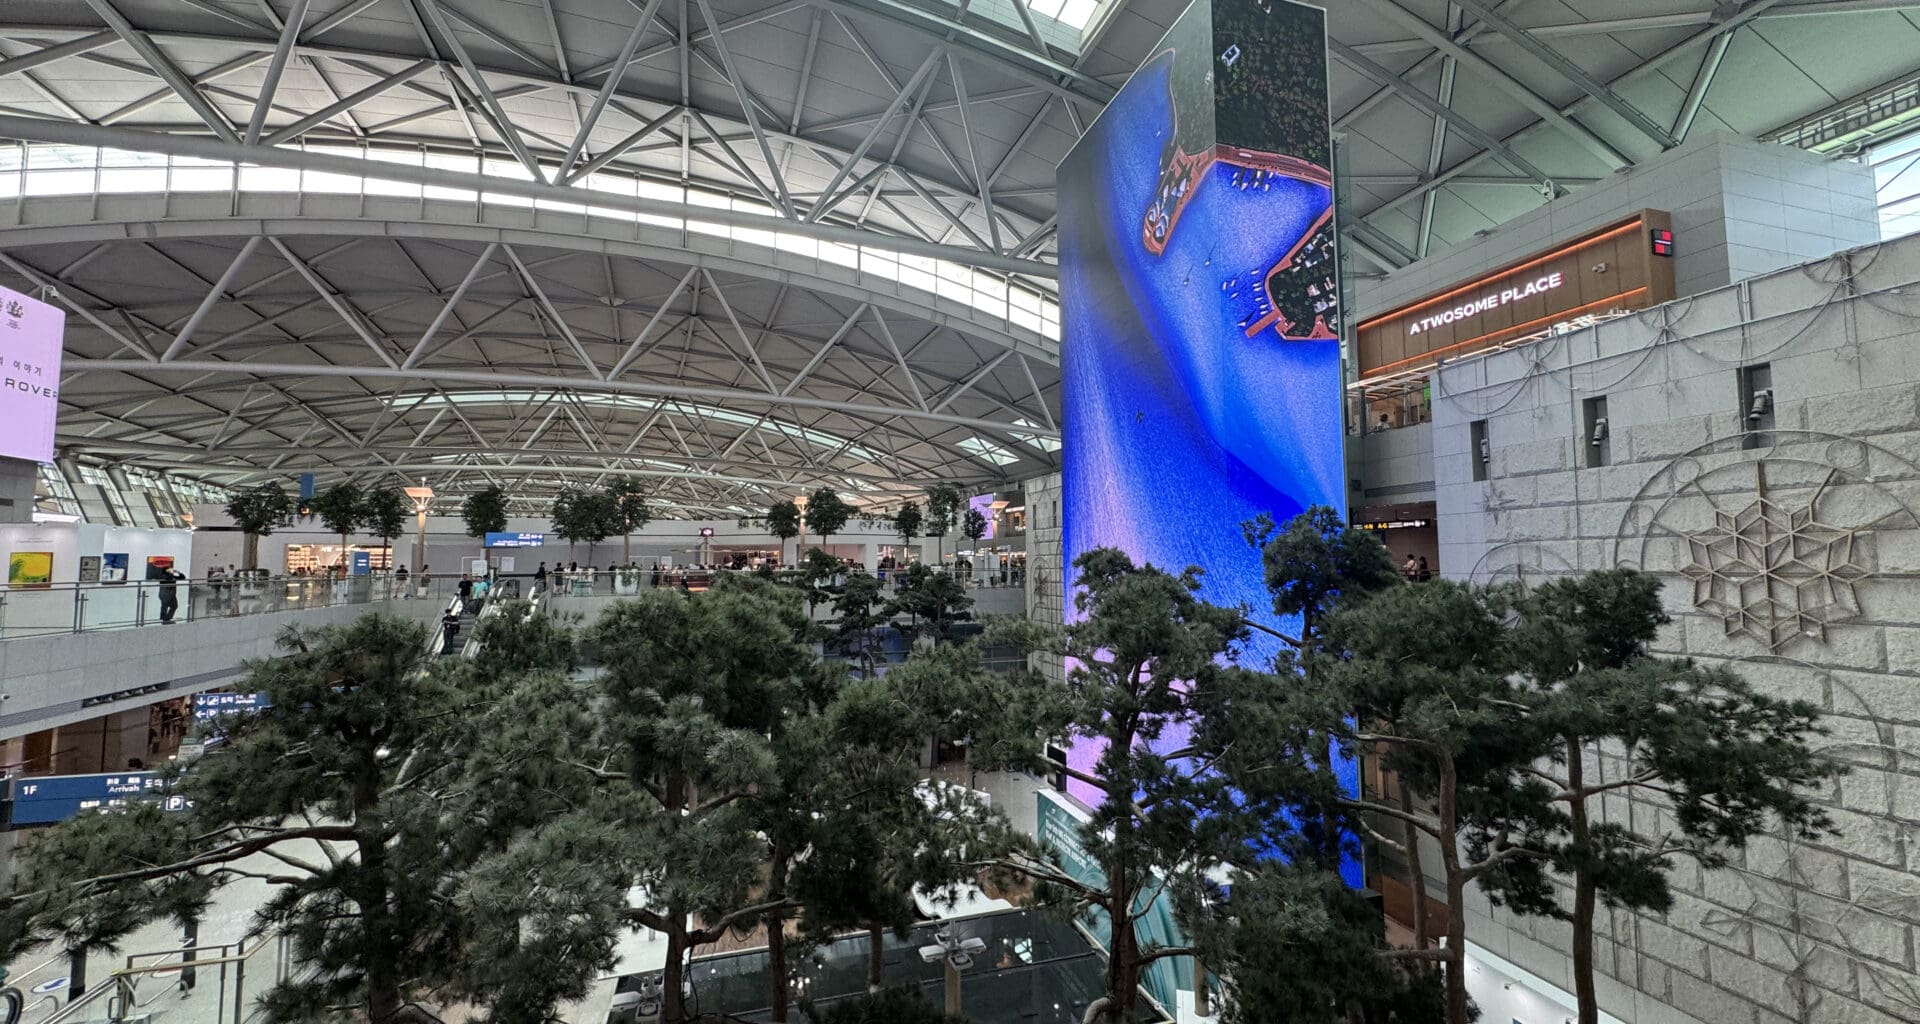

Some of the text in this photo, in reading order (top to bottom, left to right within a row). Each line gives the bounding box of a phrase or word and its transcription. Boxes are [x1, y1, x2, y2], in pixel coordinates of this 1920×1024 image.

[1421, 294, 1498, 331] TWOSOME
[1501, 272, 1562, 304] PLACE
[13, 360, 41, 376] 이야기
[23, 785, 37, 795] 1F
[108, 785, 139, 793] Arrivals
